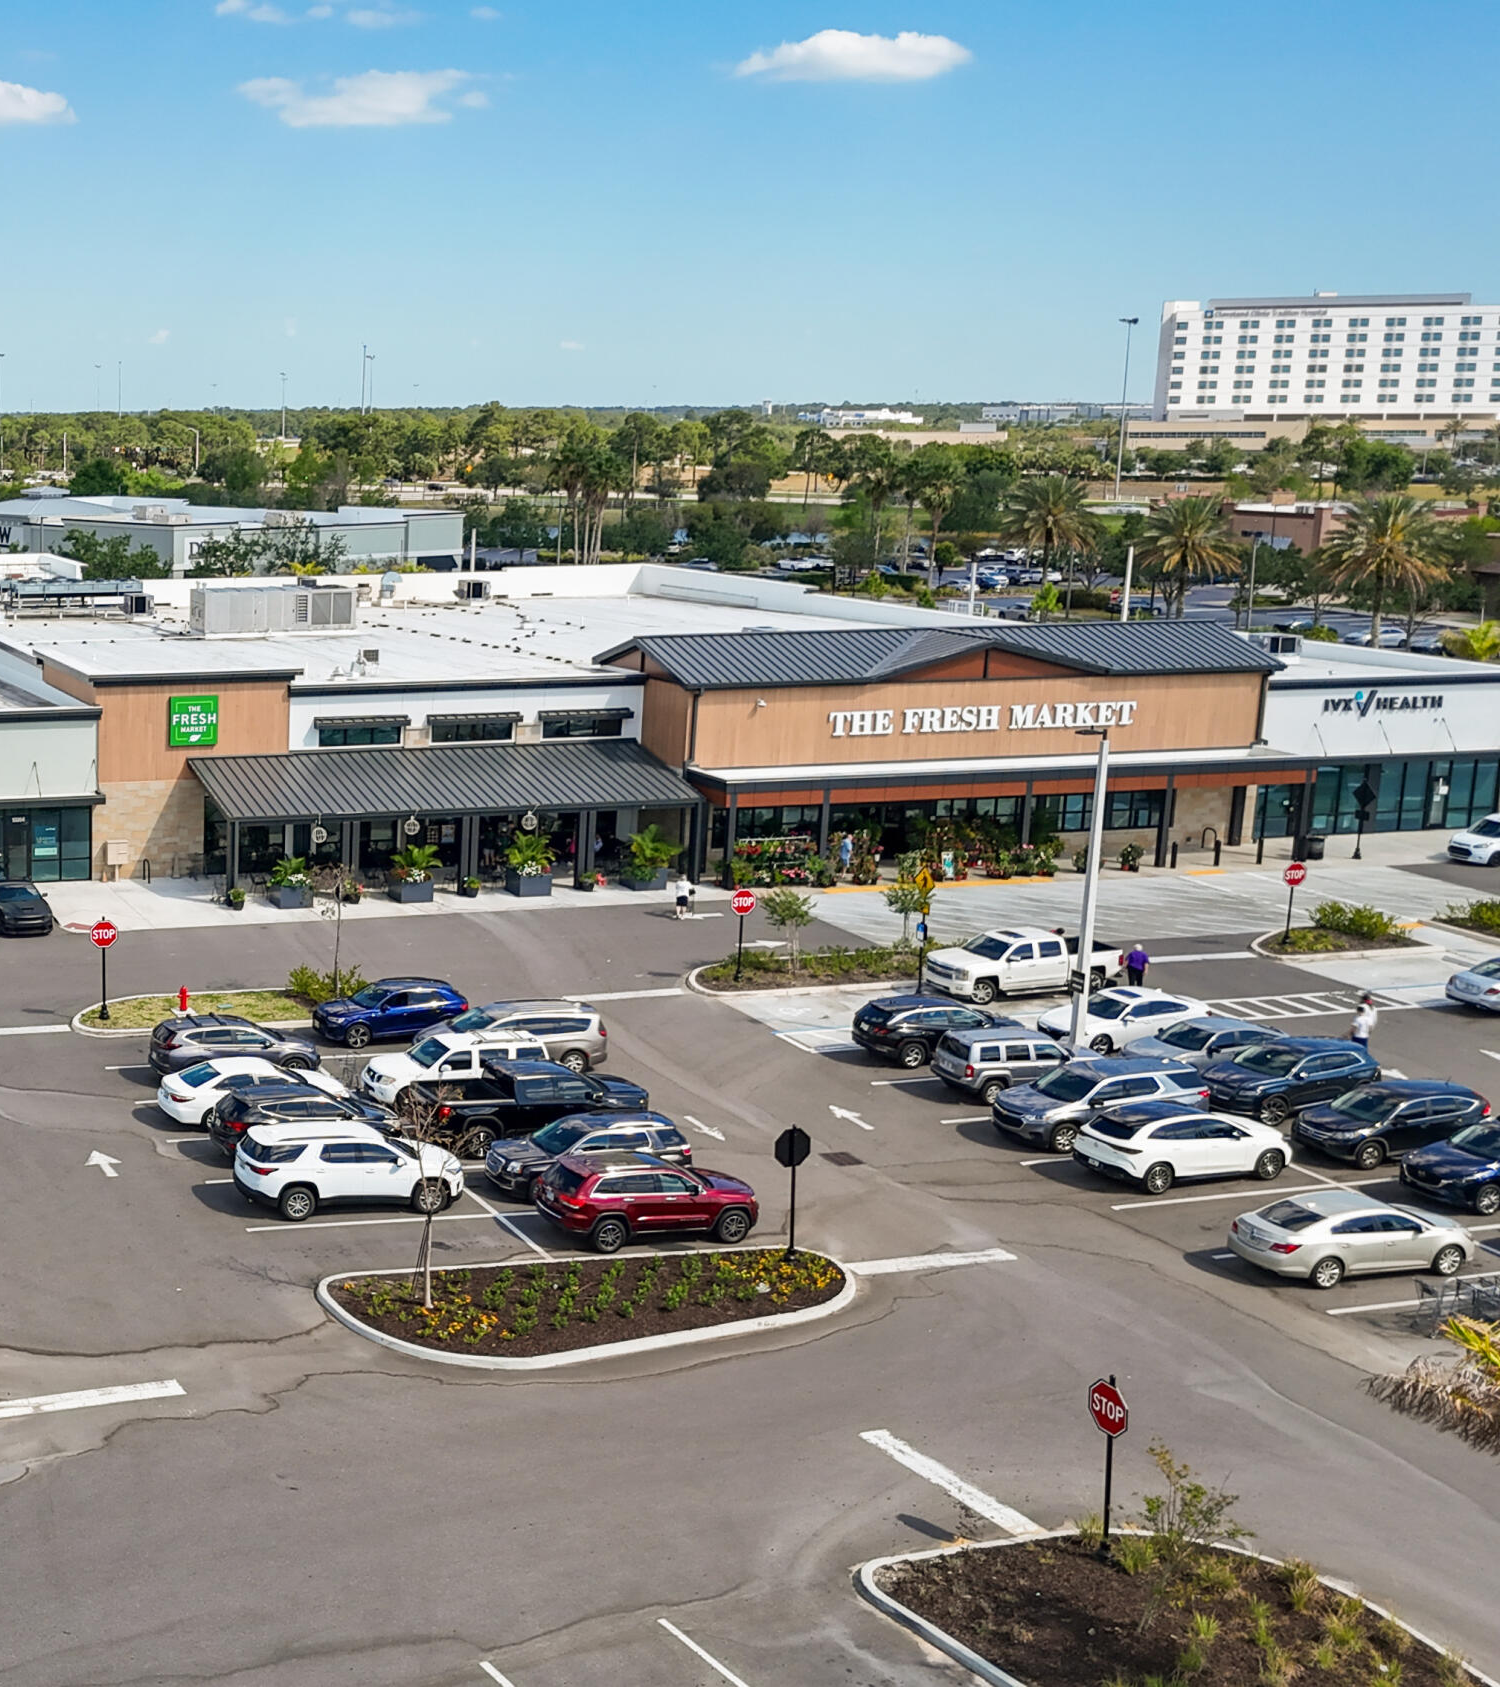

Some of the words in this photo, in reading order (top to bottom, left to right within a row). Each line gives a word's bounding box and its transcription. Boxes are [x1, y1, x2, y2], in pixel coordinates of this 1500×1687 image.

[1323, 698, 1353, 711] IVX
[1376, 696, 1443, 710] HEALTH
[172, 712, 217, 725] FRESH
[830, 710, 894, 737] THE
[902, 706, 1001, 733] FRESH
[1009, 701, 1137, 729] MARKET
[181, 725, 206, 733] MARKET
[1285, 869, 1305, 880] STOP
[733, 897, 754, 908] STOP
[92, 929, 116, 940] STOP
[1092, 1392, 1125, 1423] STOP
